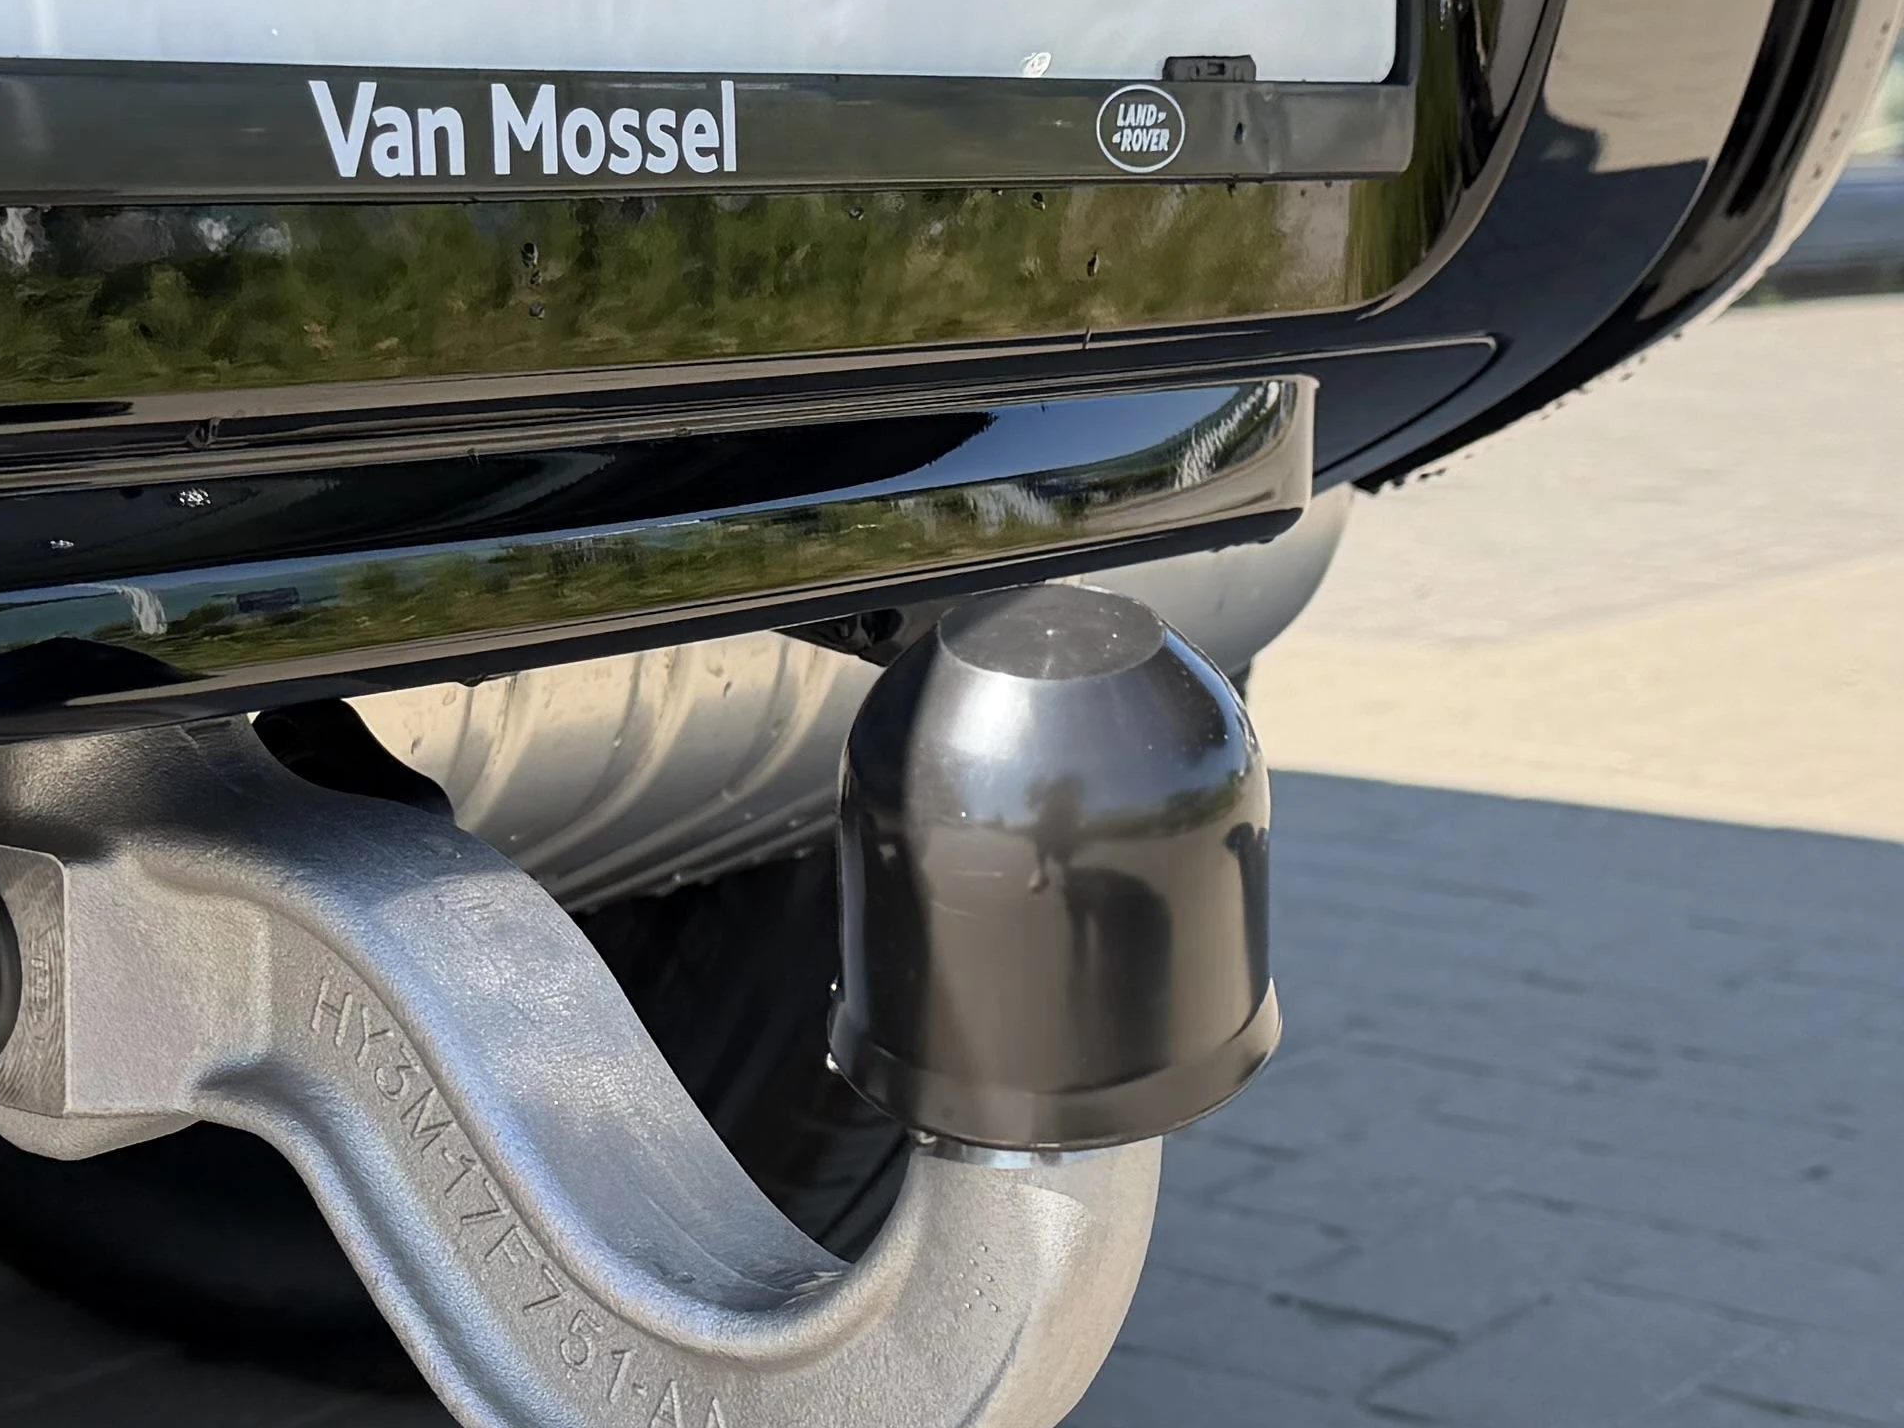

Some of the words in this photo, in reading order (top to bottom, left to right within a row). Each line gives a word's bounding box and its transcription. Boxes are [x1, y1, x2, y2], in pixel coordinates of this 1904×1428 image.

[1117, 103, 1158, 127] LAND
[308, 80, 466, 178] Van
[491, 79, 738, 176] Mossel
[1120, 128, 1170, 152] ROVER
